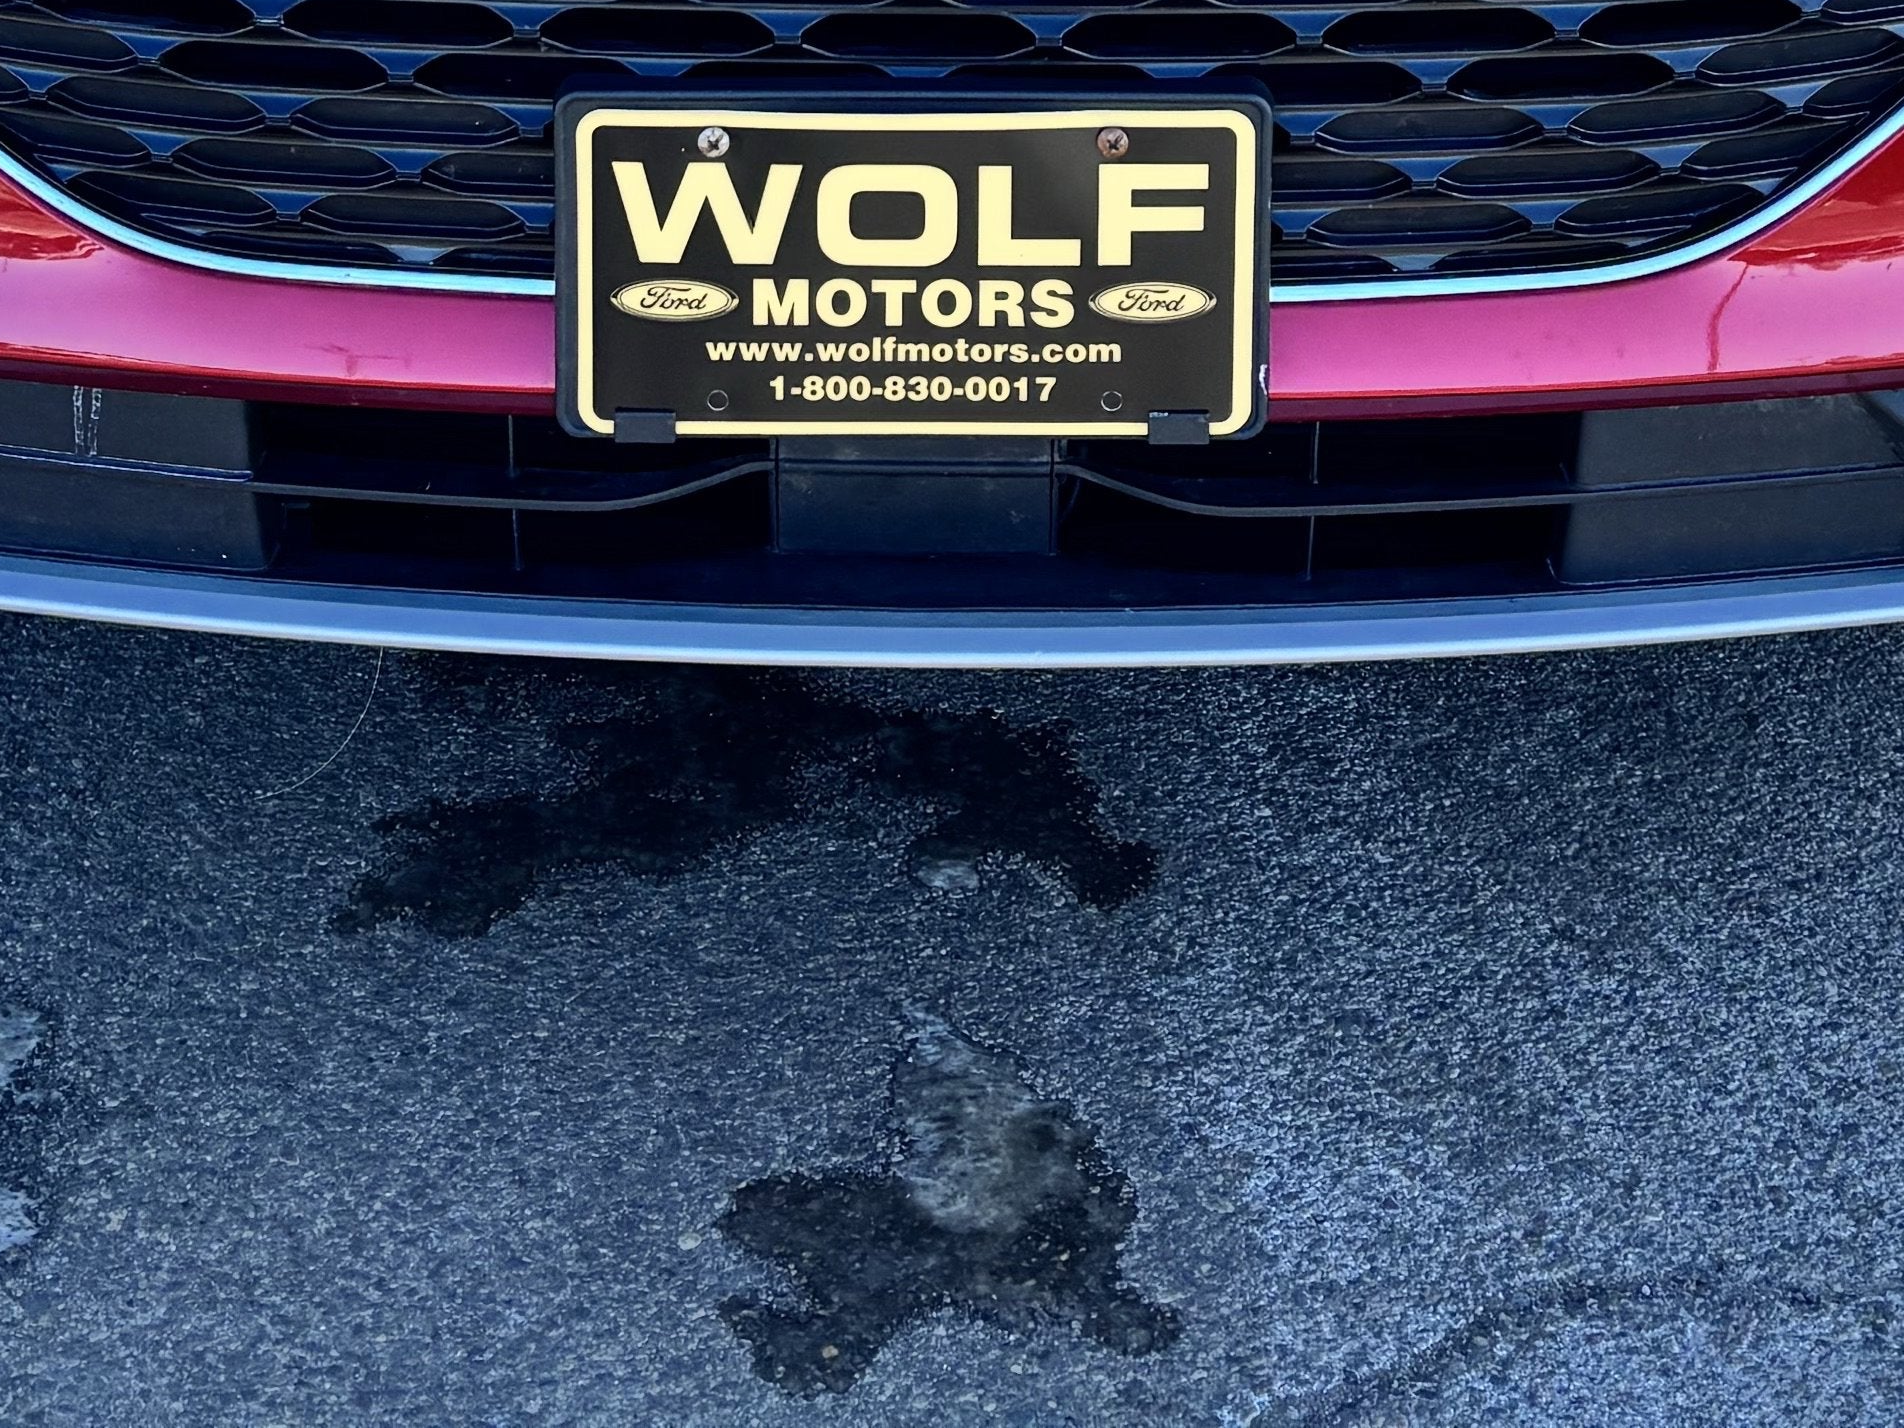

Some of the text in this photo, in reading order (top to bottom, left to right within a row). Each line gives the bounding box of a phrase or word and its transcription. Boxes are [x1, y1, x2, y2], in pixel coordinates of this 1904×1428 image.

[612, 161, 1210, 267] WOLF
[640, 286, 708, 310] Ford
[752, 278, 1076, 328] MOTORS
[1117, 288, 1187, 312] Ford
[706, 337, 1122, 364] www.wolfmotors.com
[769, 375, 1057, 403] 1-800-830-0017
